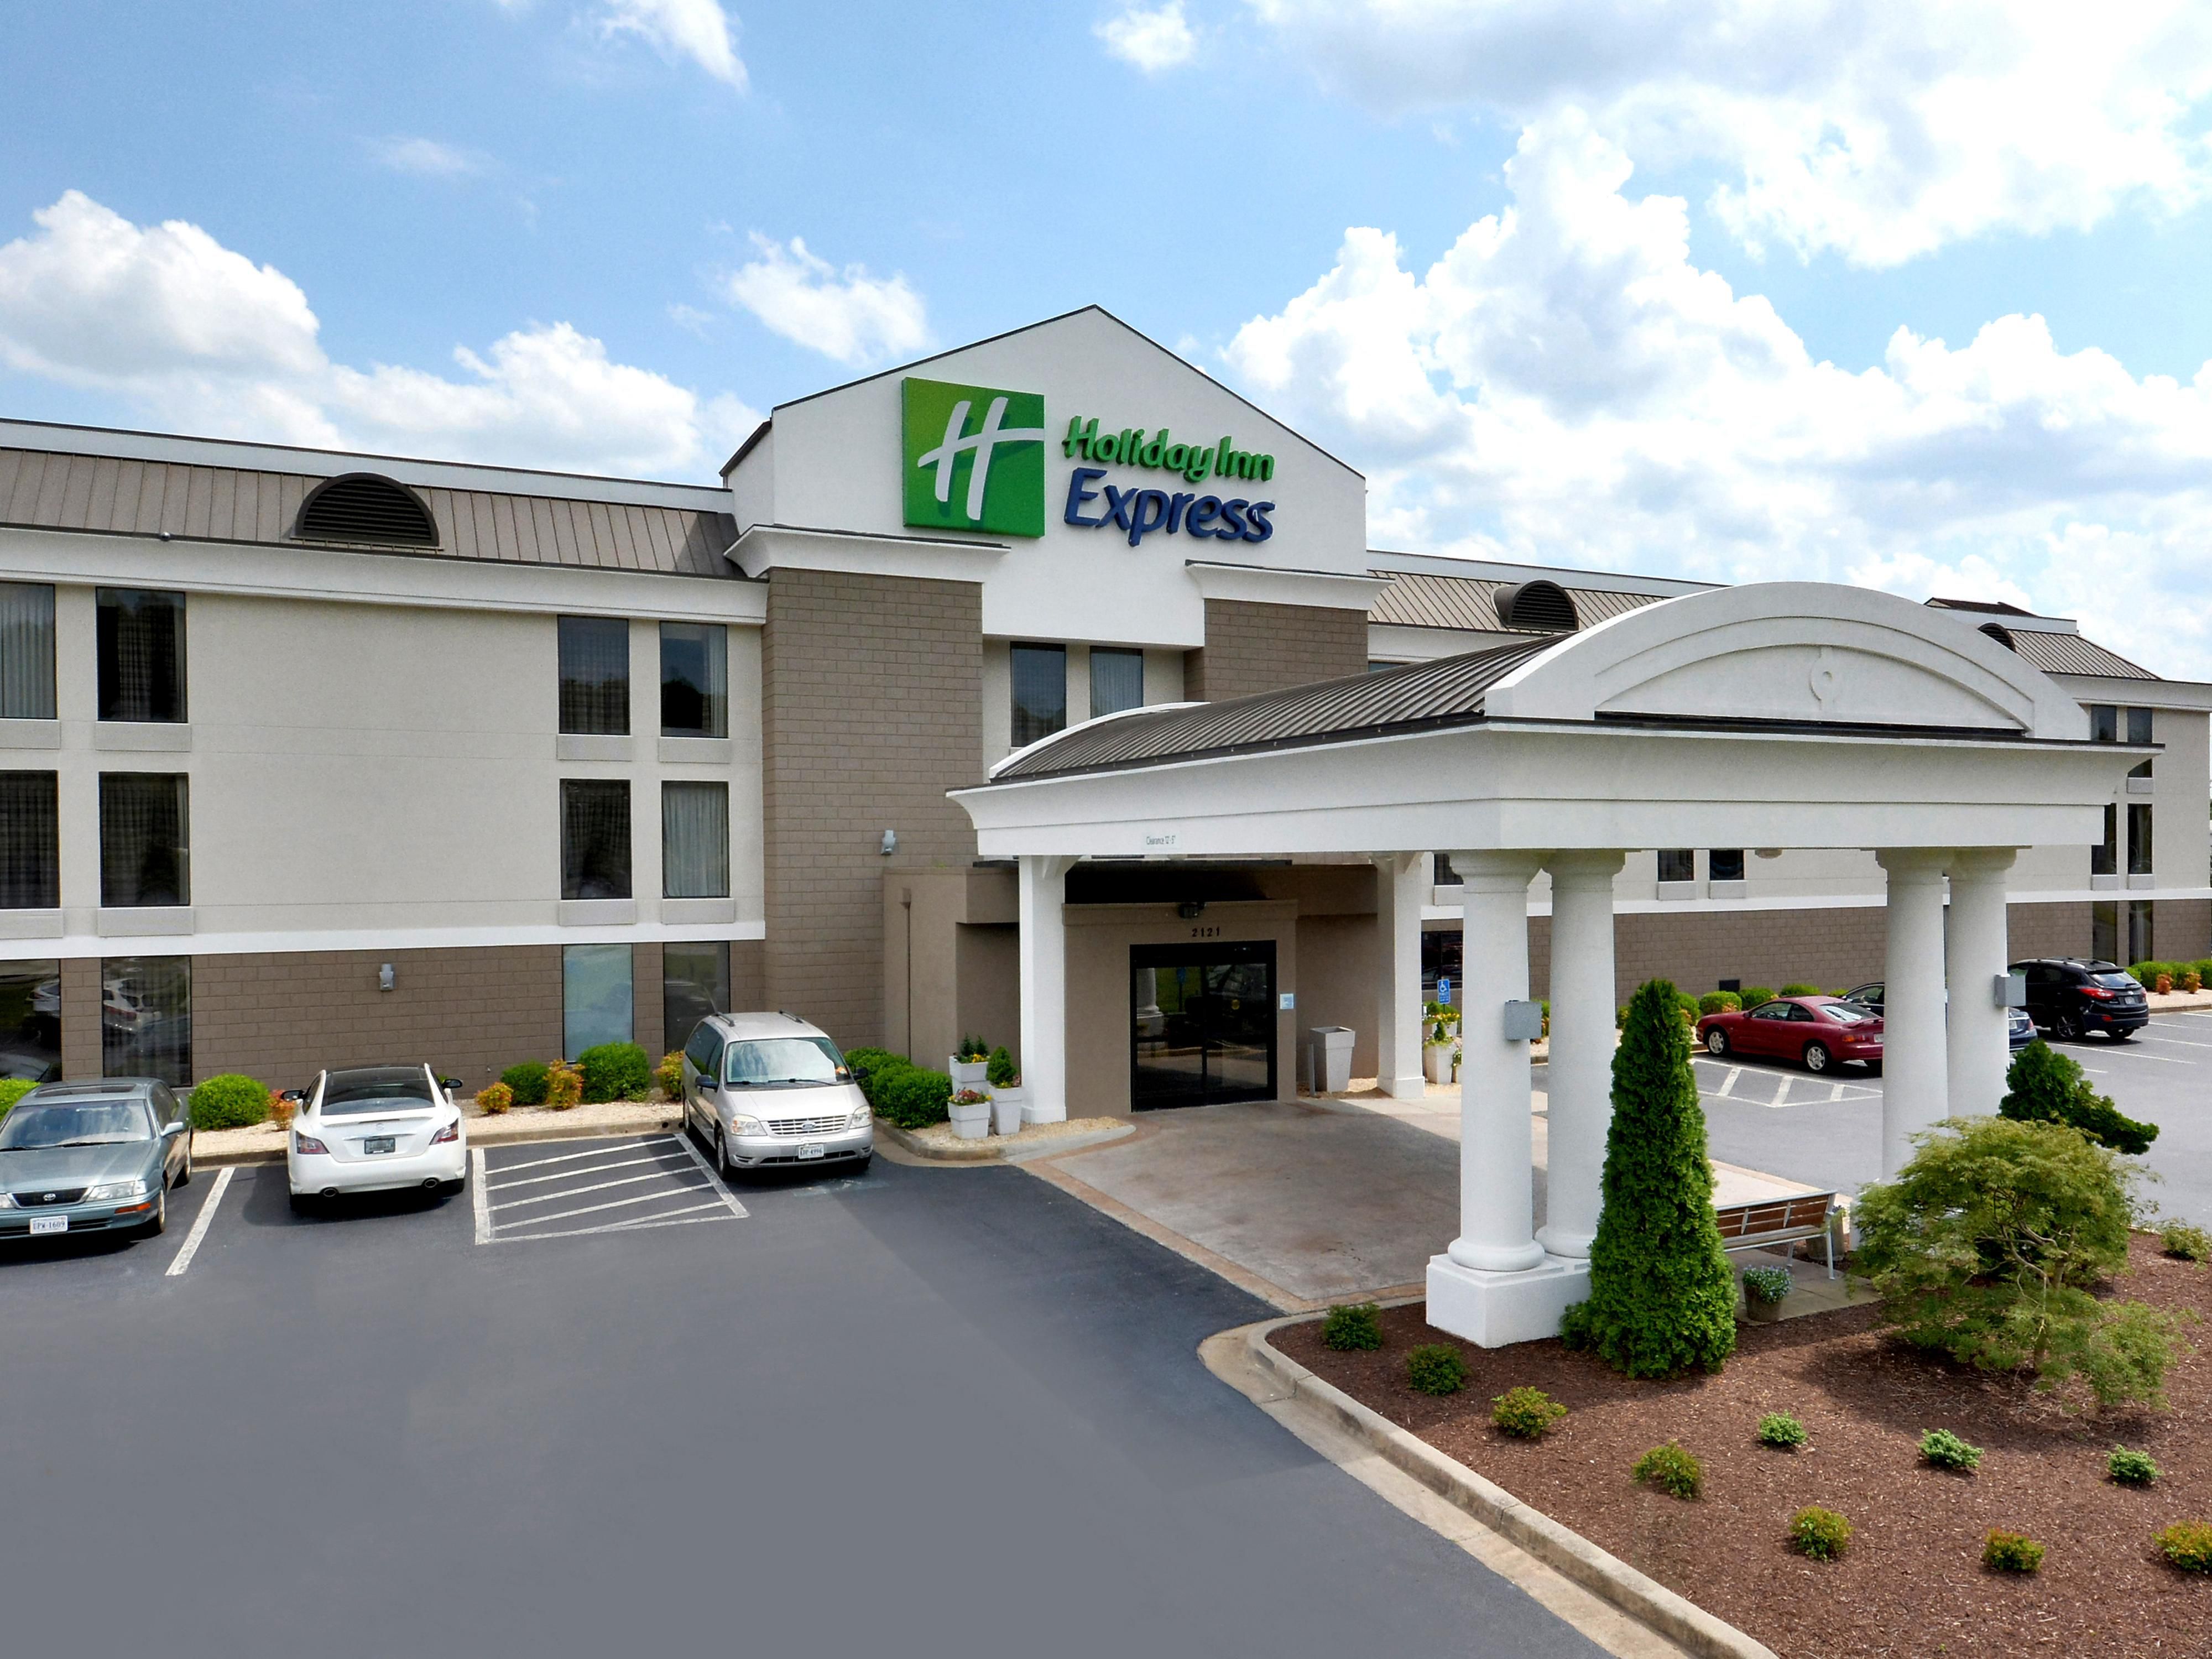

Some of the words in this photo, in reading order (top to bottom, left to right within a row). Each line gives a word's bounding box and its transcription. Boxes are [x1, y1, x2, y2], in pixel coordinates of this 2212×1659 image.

[1062, 415, 1214, 483] Holiday
[1215, 436, 1275, 481] Inn
[1063, 467, 1276, 547] Express
[1192, 927, 1220, 937] 2121
